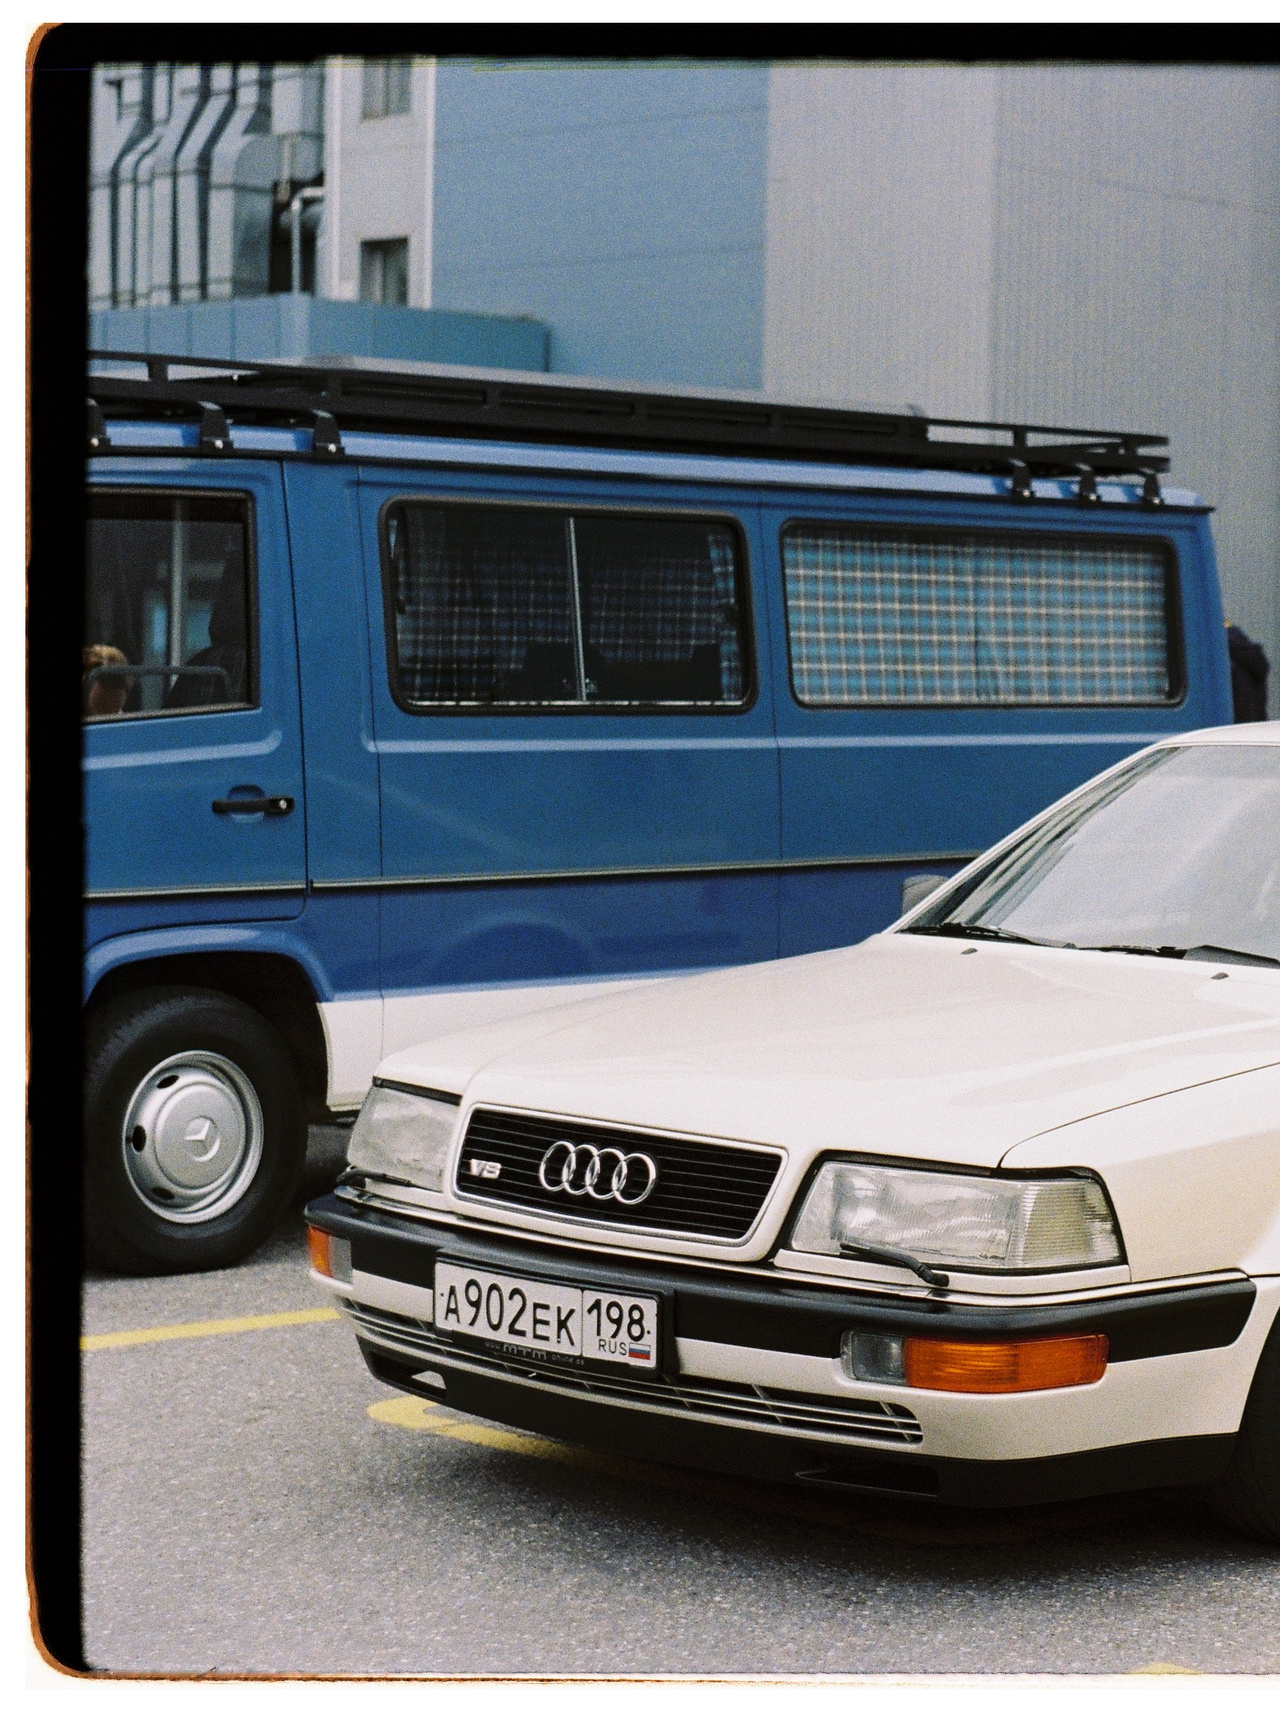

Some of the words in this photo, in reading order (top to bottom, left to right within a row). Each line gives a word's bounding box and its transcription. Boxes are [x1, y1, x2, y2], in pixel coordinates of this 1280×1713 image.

[470, 1158, 502, 1179] V8
[586, 1298, 646, 1342] 198
[598, 1338, 628, 1356] RUS
